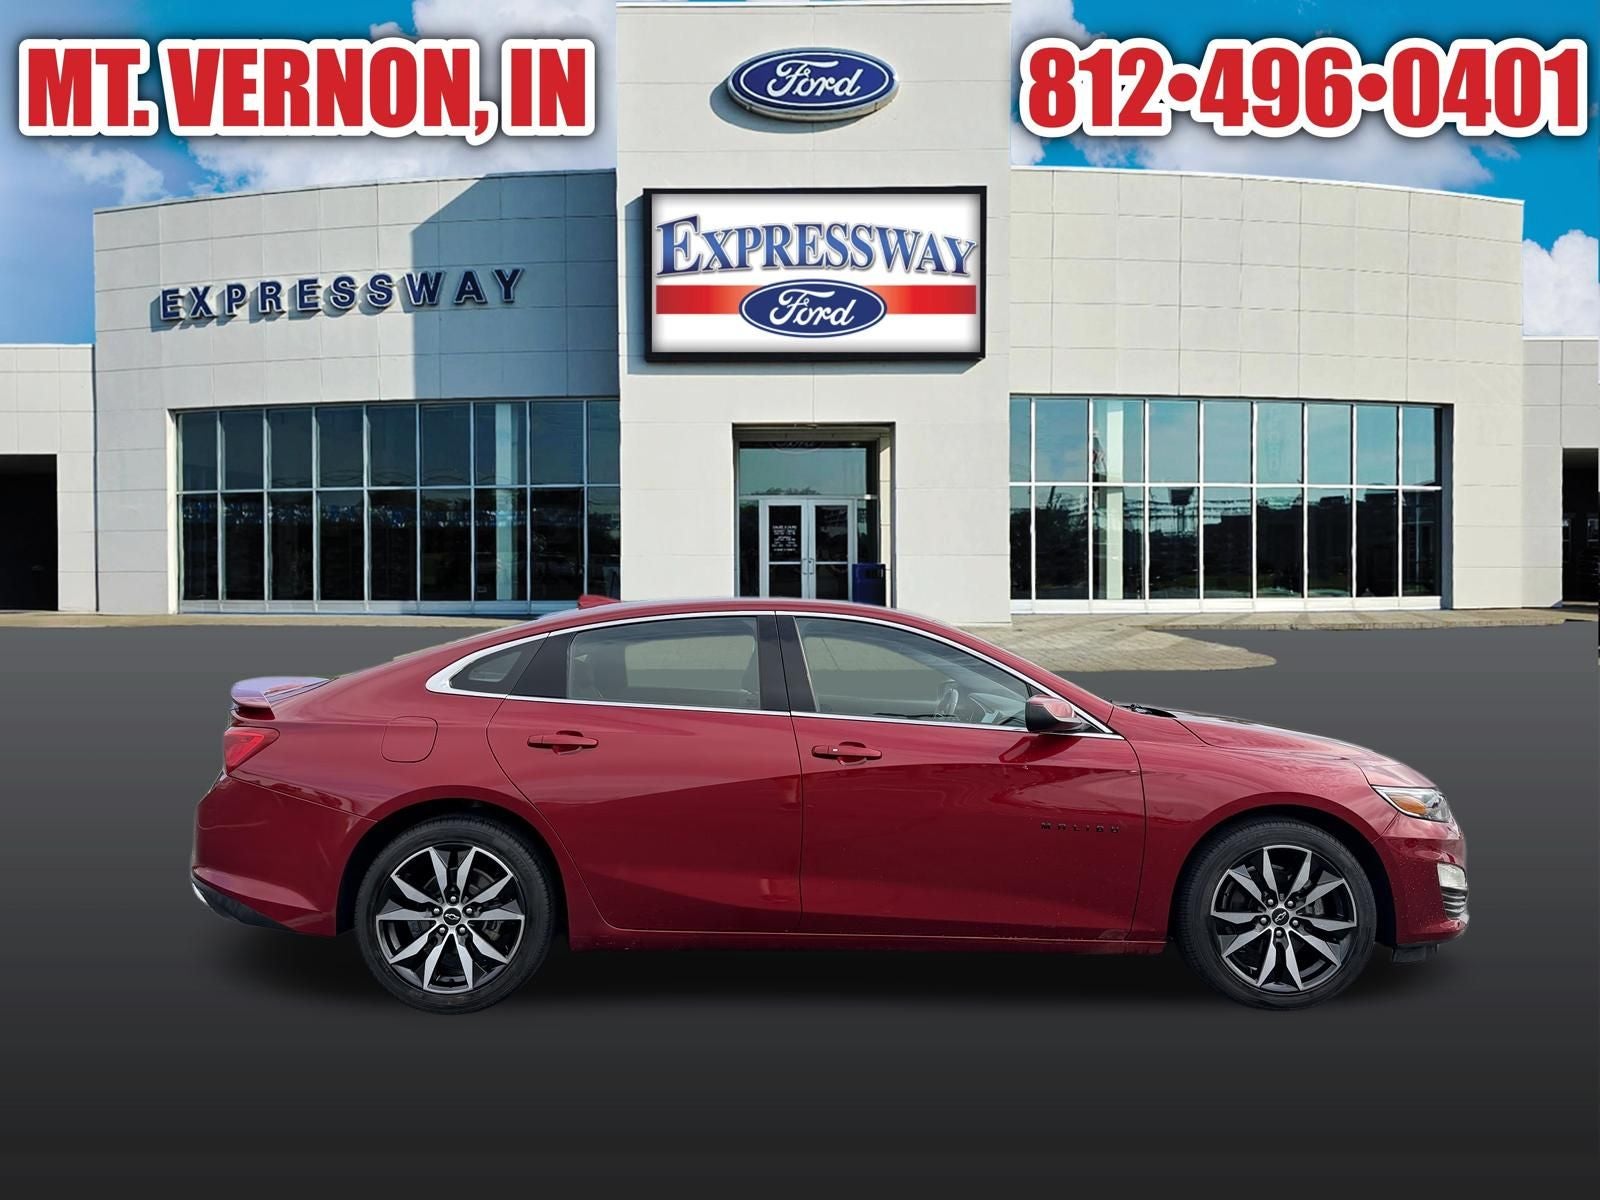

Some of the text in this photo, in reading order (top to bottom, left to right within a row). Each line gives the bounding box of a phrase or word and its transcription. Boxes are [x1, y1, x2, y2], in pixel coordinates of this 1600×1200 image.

[766, 59, 864, 97] Ford
[656, 214, 976, 277] EXPRESSWAY
[160, 268, 524, 321] EXPRESSWAY
[769, 288, 857, 326] Ford
[1041, 822, 1120, 833] MALIBU
